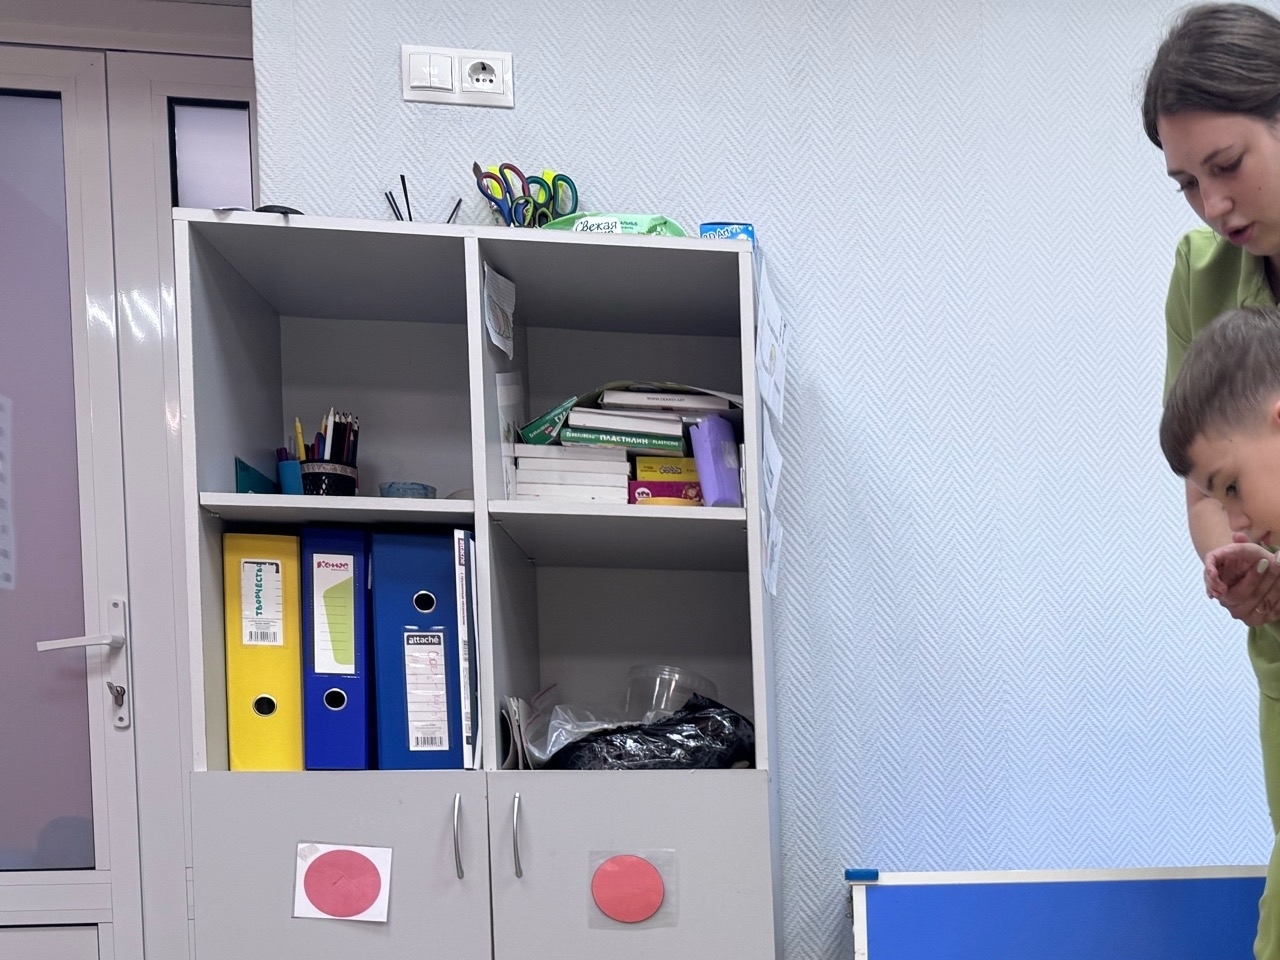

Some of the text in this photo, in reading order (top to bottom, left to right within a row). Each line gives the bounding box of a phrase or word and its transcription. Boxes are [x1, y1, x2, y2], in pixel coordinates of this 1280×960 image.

[569, 431, 595, 439] BRAUBERG
[600, 434, 648, 444] ПЛАСТИЛИН
[255, 562, 263, 617] ТВОРЧЕСТВО
[408, 636, 439, 644] attaché
